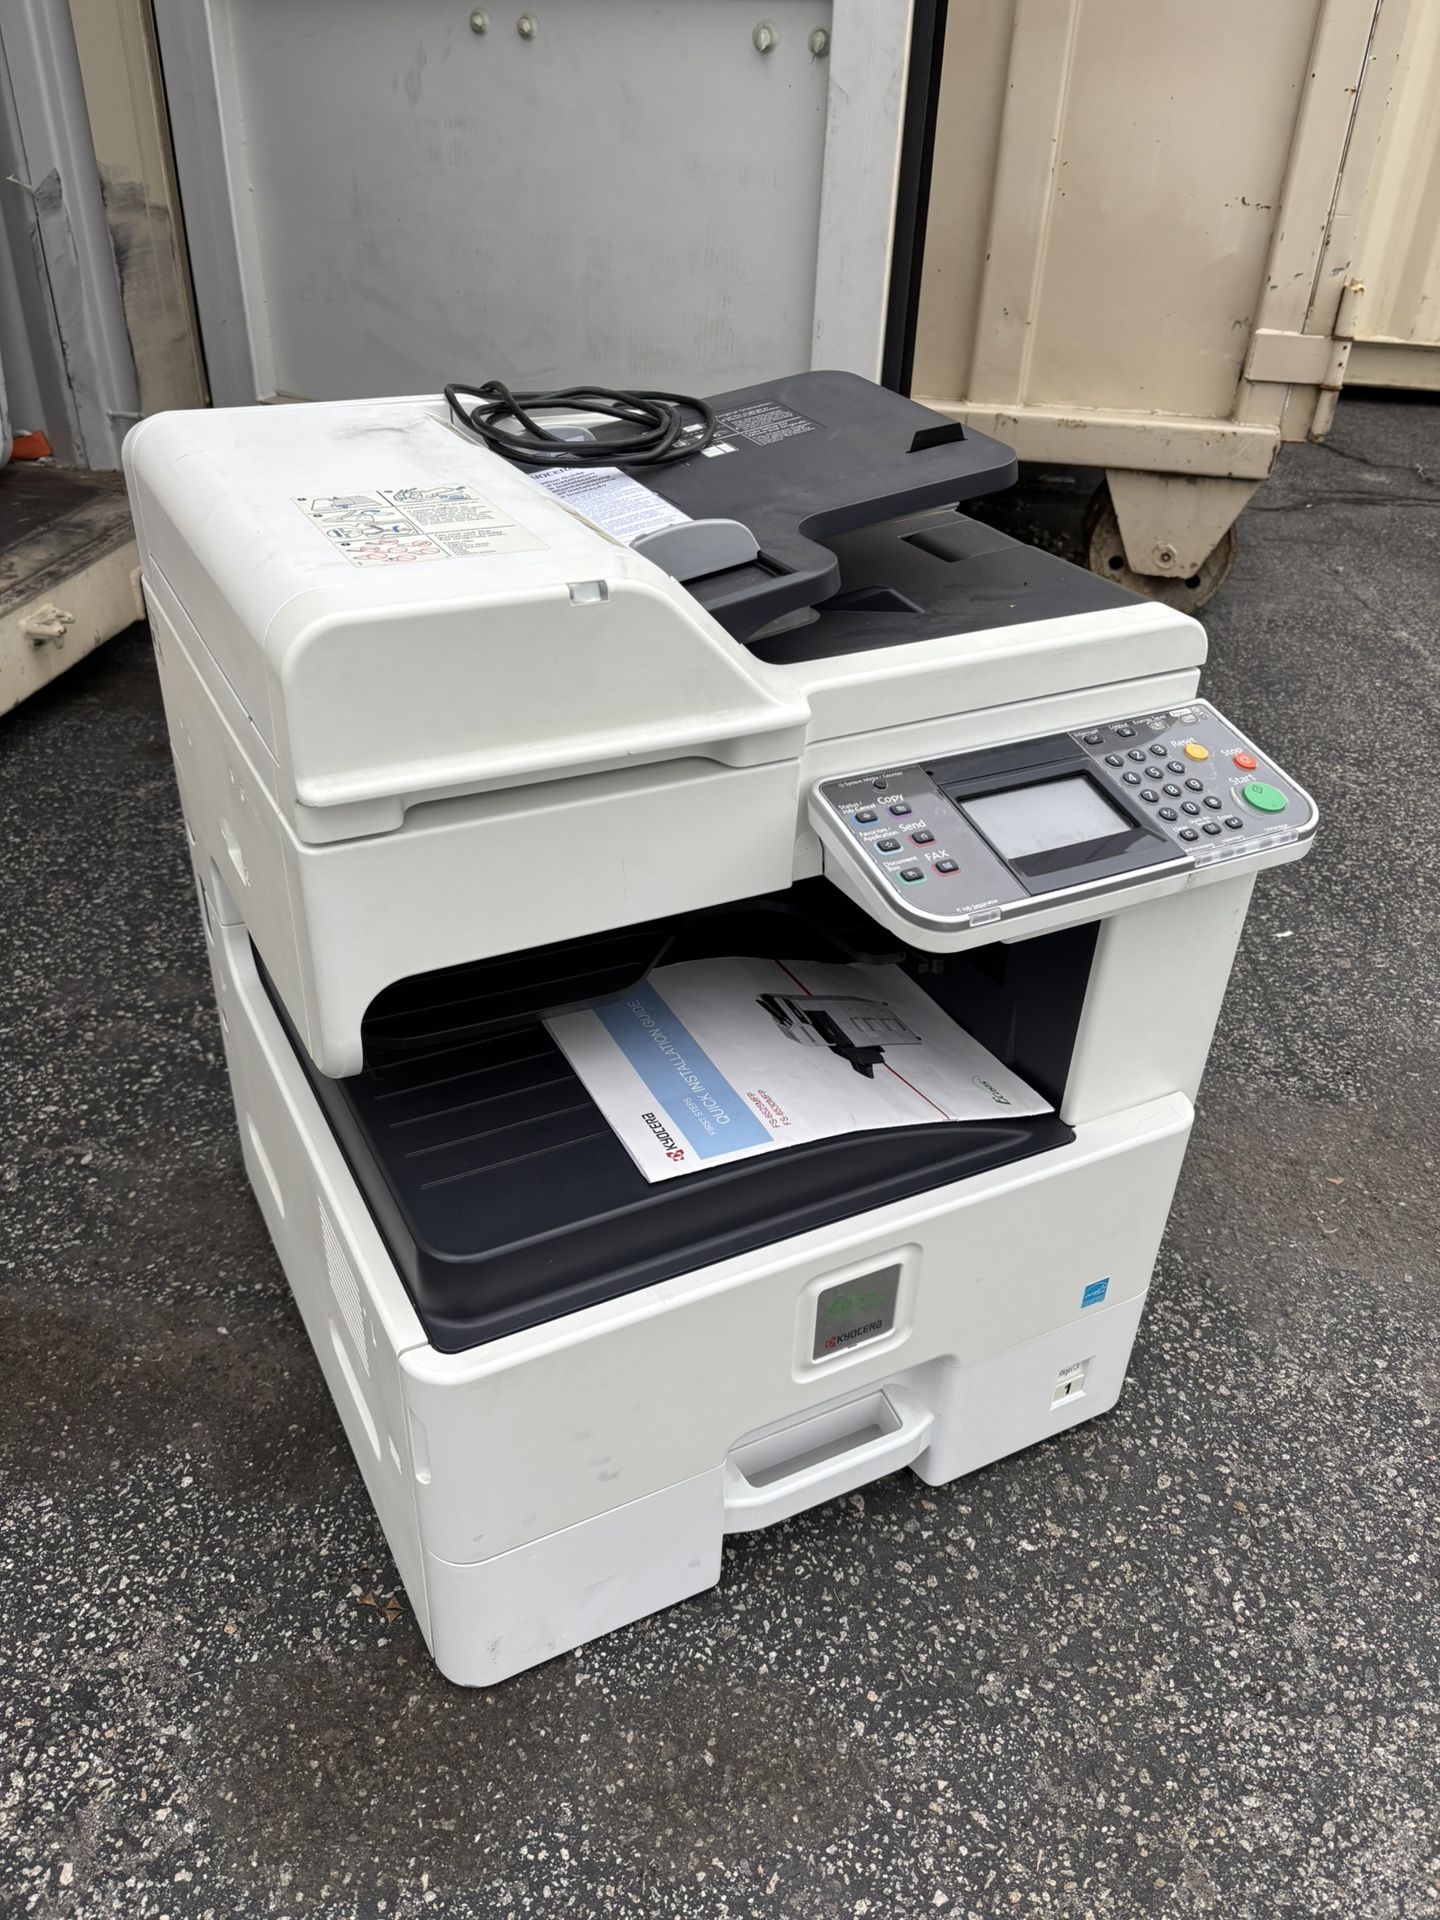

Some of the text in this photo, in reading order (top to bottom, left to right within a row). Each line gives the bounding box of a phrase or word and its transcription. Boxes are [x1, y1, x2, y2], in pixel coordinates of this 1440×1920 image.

[1170, 737, 1198, 747] Reset
[1154, 745, 1165, 754] 3
[1220, 747, 1243, 757] Stop
[1110, 755, 1119, 764] 1
[1133, 750, 1144, 760] 2
[1149, 767, 1160, 776] 5
[1172, 762, 1182, 771] 6
[1128, 773, 1137, 782] 4
[1228, 774, 1257, 786] Start
[1190, 780, 1200, 788] 9
[1145, 790, 1153, 799] 7
[1167, 785, 1178, 794] 8
[877, 793, 904, 805] Copy
[1186, 803, 1196, 812] 0
[898, 819, 927, 833] Send
[924, 849, 950, 862] FAX
[882, 855, 918, 868] Document
[626, 1000, 730, 1125] QUICK INSTALLATION GUIDE
[683, 1096, 718, 1136] FIRST STEPS
[641, 1112, 678, 1151] KYOCERA
[836, 1319, 883, 1345] KYOCERA
[1064, 1382, 1072, 1395] 1
